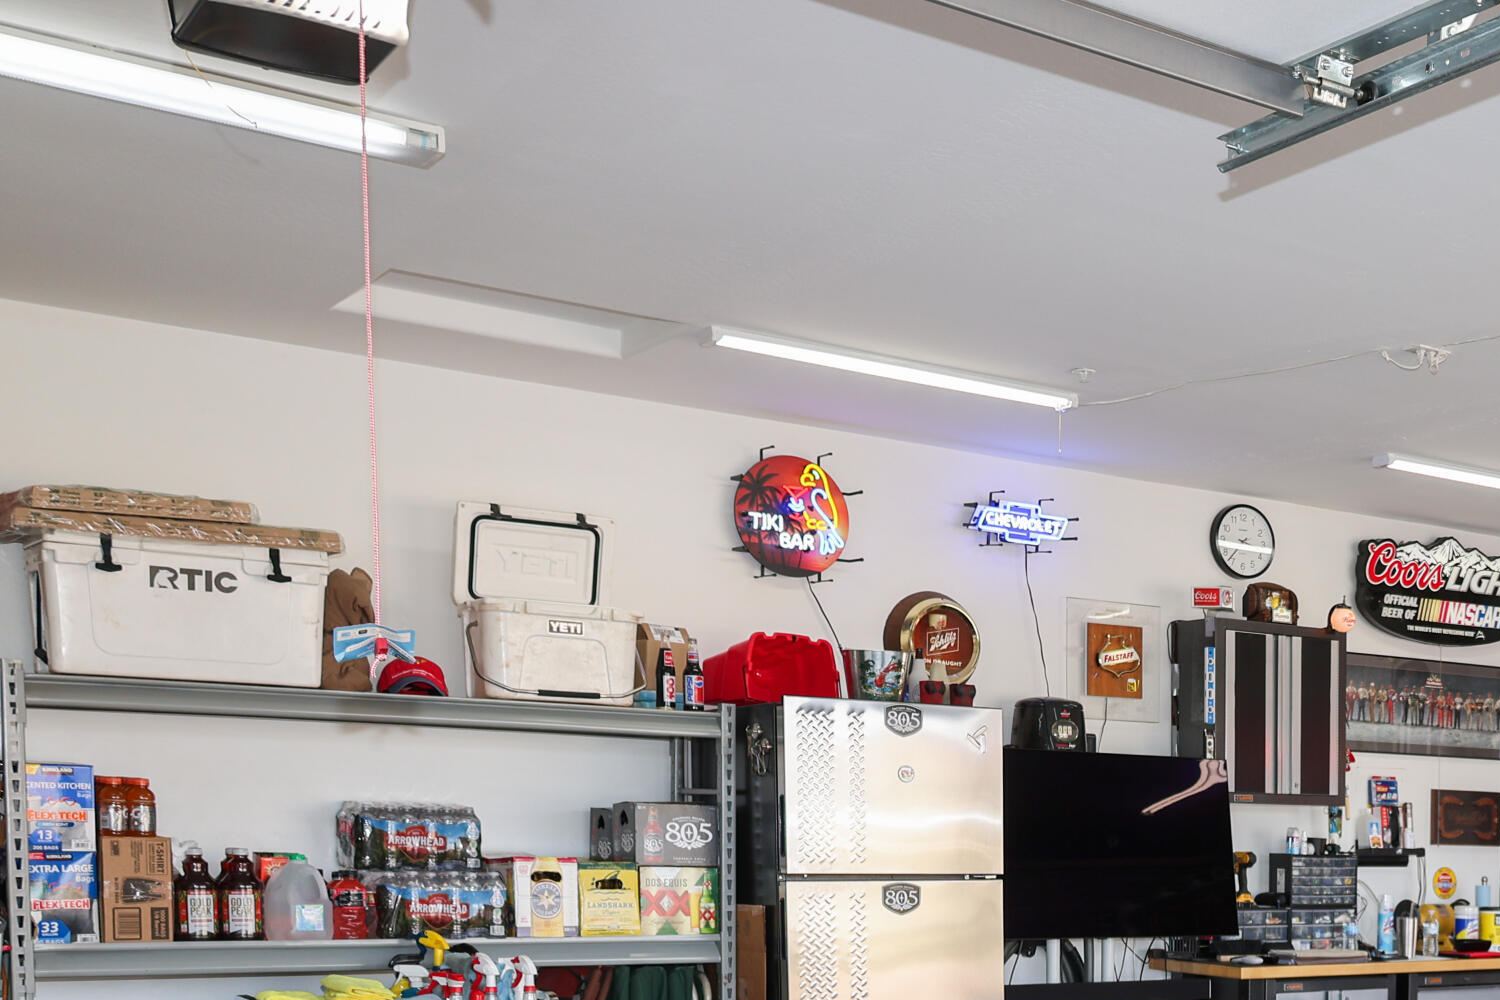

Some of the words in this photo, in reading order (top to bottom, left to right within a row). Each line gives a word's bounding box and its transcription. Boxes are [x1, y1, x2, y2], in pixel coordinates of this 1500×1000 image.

[748, 511, 784, 533] TIKI
[985, 511, 1061, 535] CHEVROLET
[779, 531, 815, 551] BAR
[1365, 541, 1445, 592] Coors
[149, 565, 238, 593] RTIC
[1383, 593, 1419, 608] OFFICIAL
[1381, 606, 1403, 620] BEER
[1405, 608, 1417, 620] OF
[550, 621, 582, 635] YETI
[929, 631, 957, 652] Schlitz
[1104, 651, 1135, 663] FALSTAFF
[886, 711, 921, 727] 805
[26, 781, 57, 789] CENTED
[57, 782, 92, 790] KITCHEN
[37, 829, 53, 840] 13
[665, 821, 713, 843] 805
[388, 835, 445, 847] ARROWHEAD
[156, 842, 165, 873] T-SHIRT
[29, 864, 60, 873] EXTRA
[61, 864, 93, 873] LARGE
[76, 875, 94, 883] Bags
[645, 878, 662, 887] DOS
[664, 878, 688, 888] EQUIS
[885, 890, 921, 905] 805
[409, 903, 468, 914] ARROWHEAD
[587, 901, 634, 909] LANDSHARK
[41, 921, 59, 933] 33
